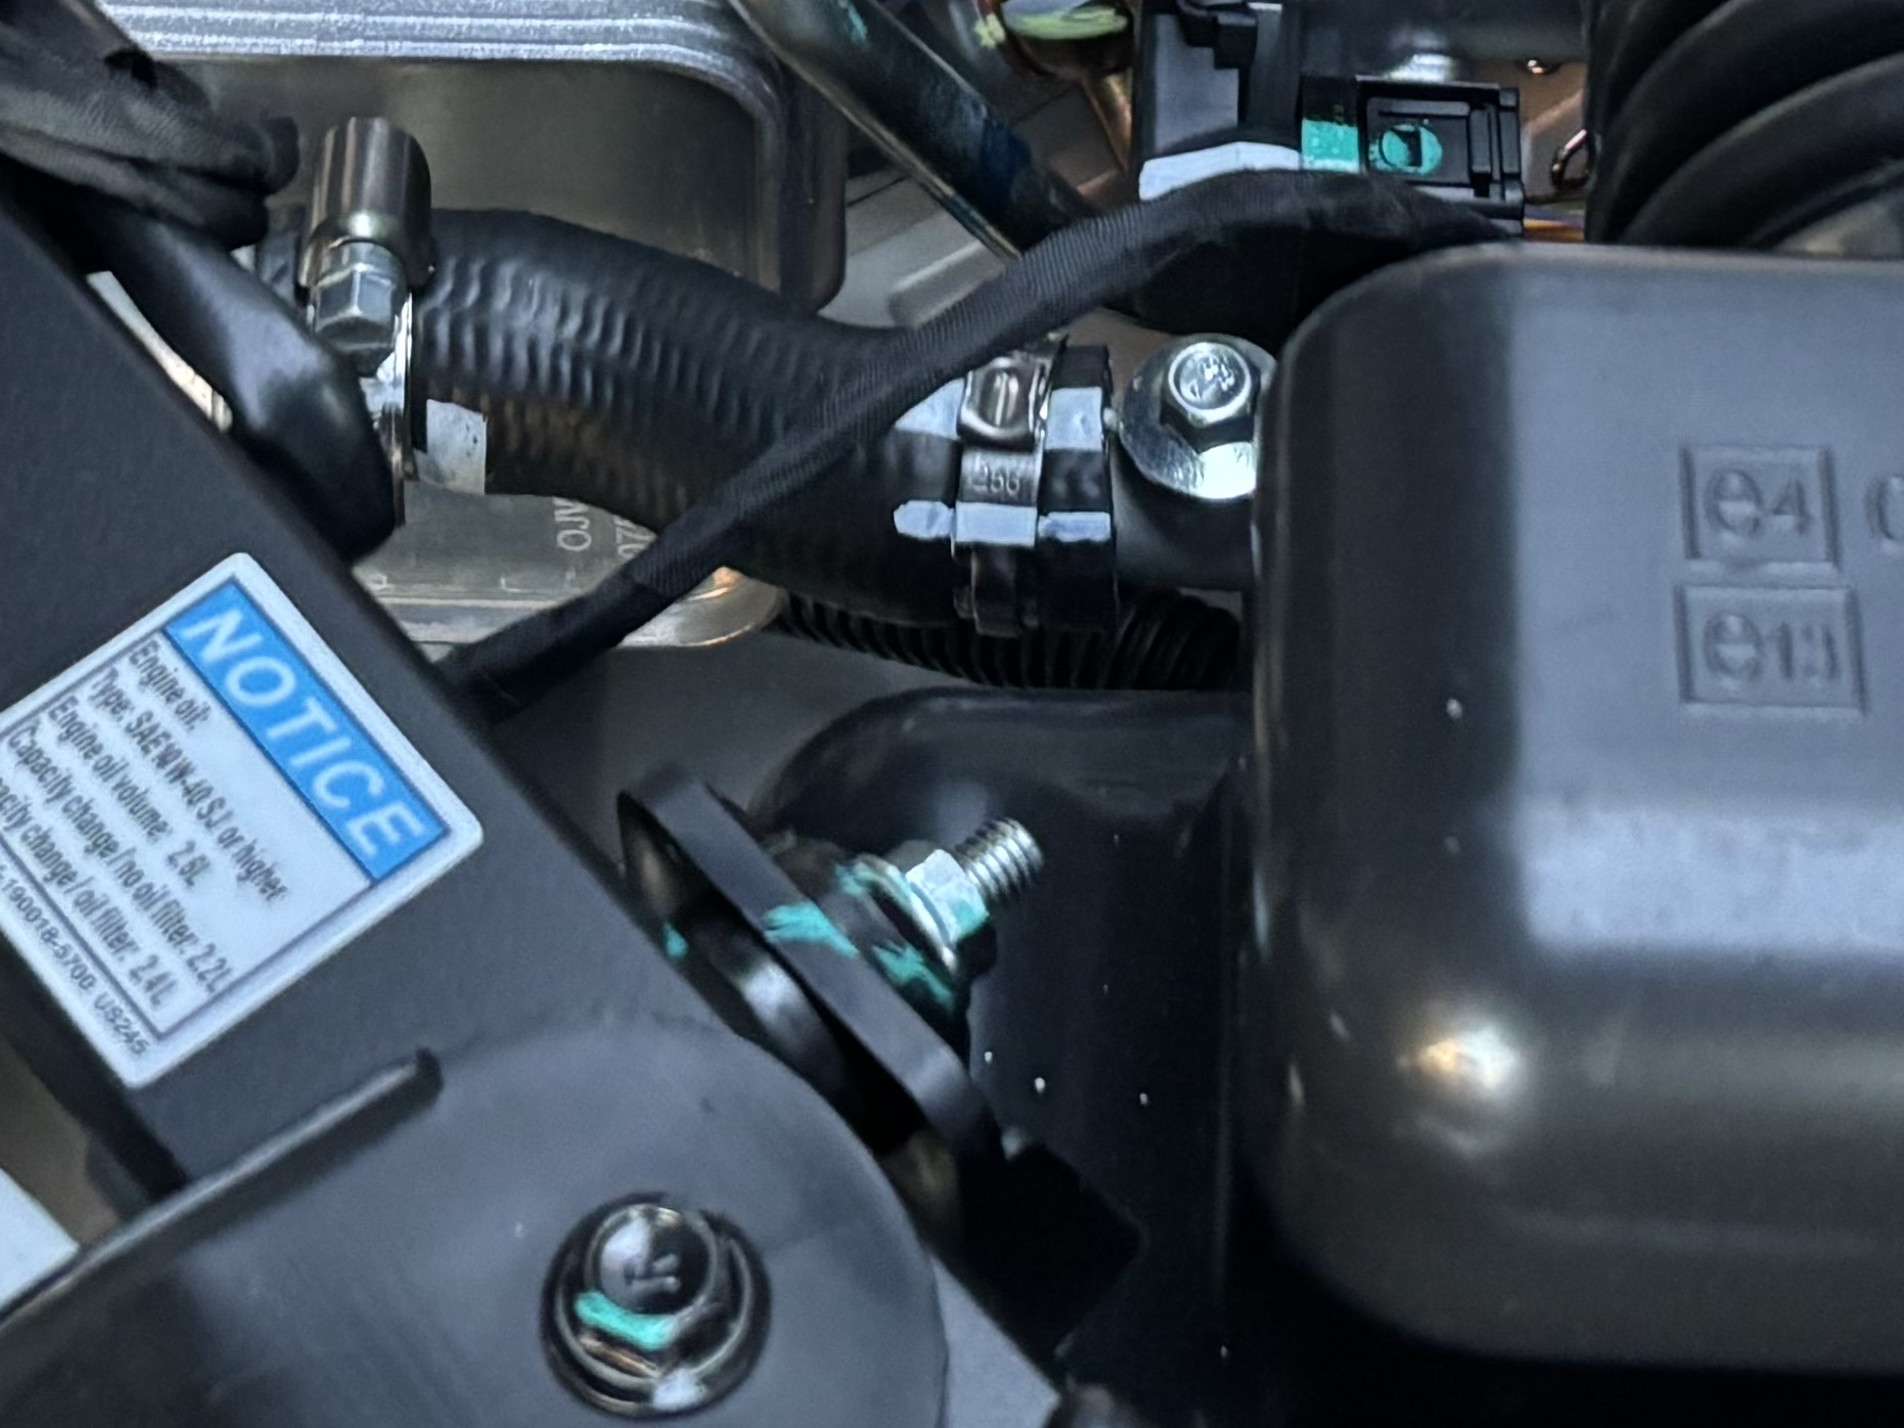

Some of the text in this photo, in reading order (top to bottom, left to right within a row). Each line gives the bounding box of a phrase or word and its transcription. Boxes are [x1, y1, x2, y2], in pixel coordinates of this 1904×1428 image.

[89, 666, 134, 720] Type:
[128, 637, 208, 731] Engine oil:
[178, 599, 427, 859] NOTICE
[6, 723, 75, 803] Capacity
[47, 694, 107, 761] Engine
[91, 752, 128, 782] oil
[110, 776, 174, 843] volume:
[193, 795, 234, 830] SJ
[214, 822, 247, 850] or
[130, 880, 170, 911] oil
[230, 838, 290, 903] higher
[148, 898, 197, 954] filter:
[88, 906, 141, 964] filter:
[126, 952, 180, 1007] 2.4L
[185, 942, 234, 993] 2.2L
